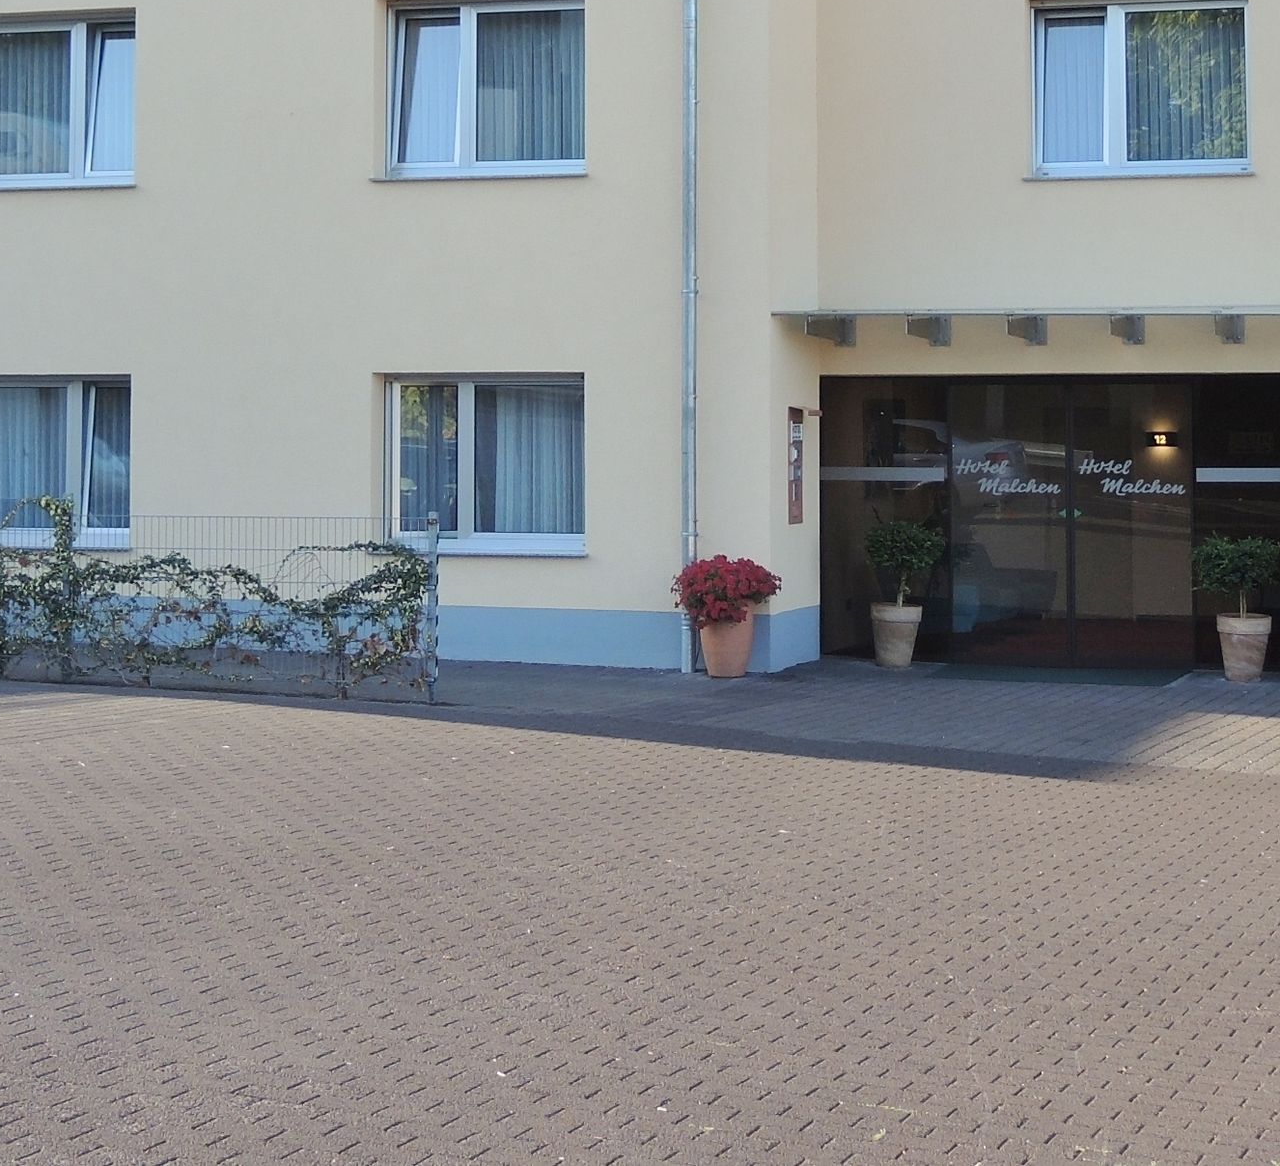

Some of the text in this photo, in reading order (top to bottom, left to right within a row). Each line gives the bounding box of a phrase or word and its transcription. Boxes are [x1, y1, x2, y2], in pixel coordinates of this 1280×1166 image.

[1153, 434, 1167, 445] 12
[955, 458, 1010, 475] Hotel
[1078, 458, 1133, 475] Hotel
[977, 477, 1062, 496] Malchen
[1100, 477, 1186, 496] Malchen
